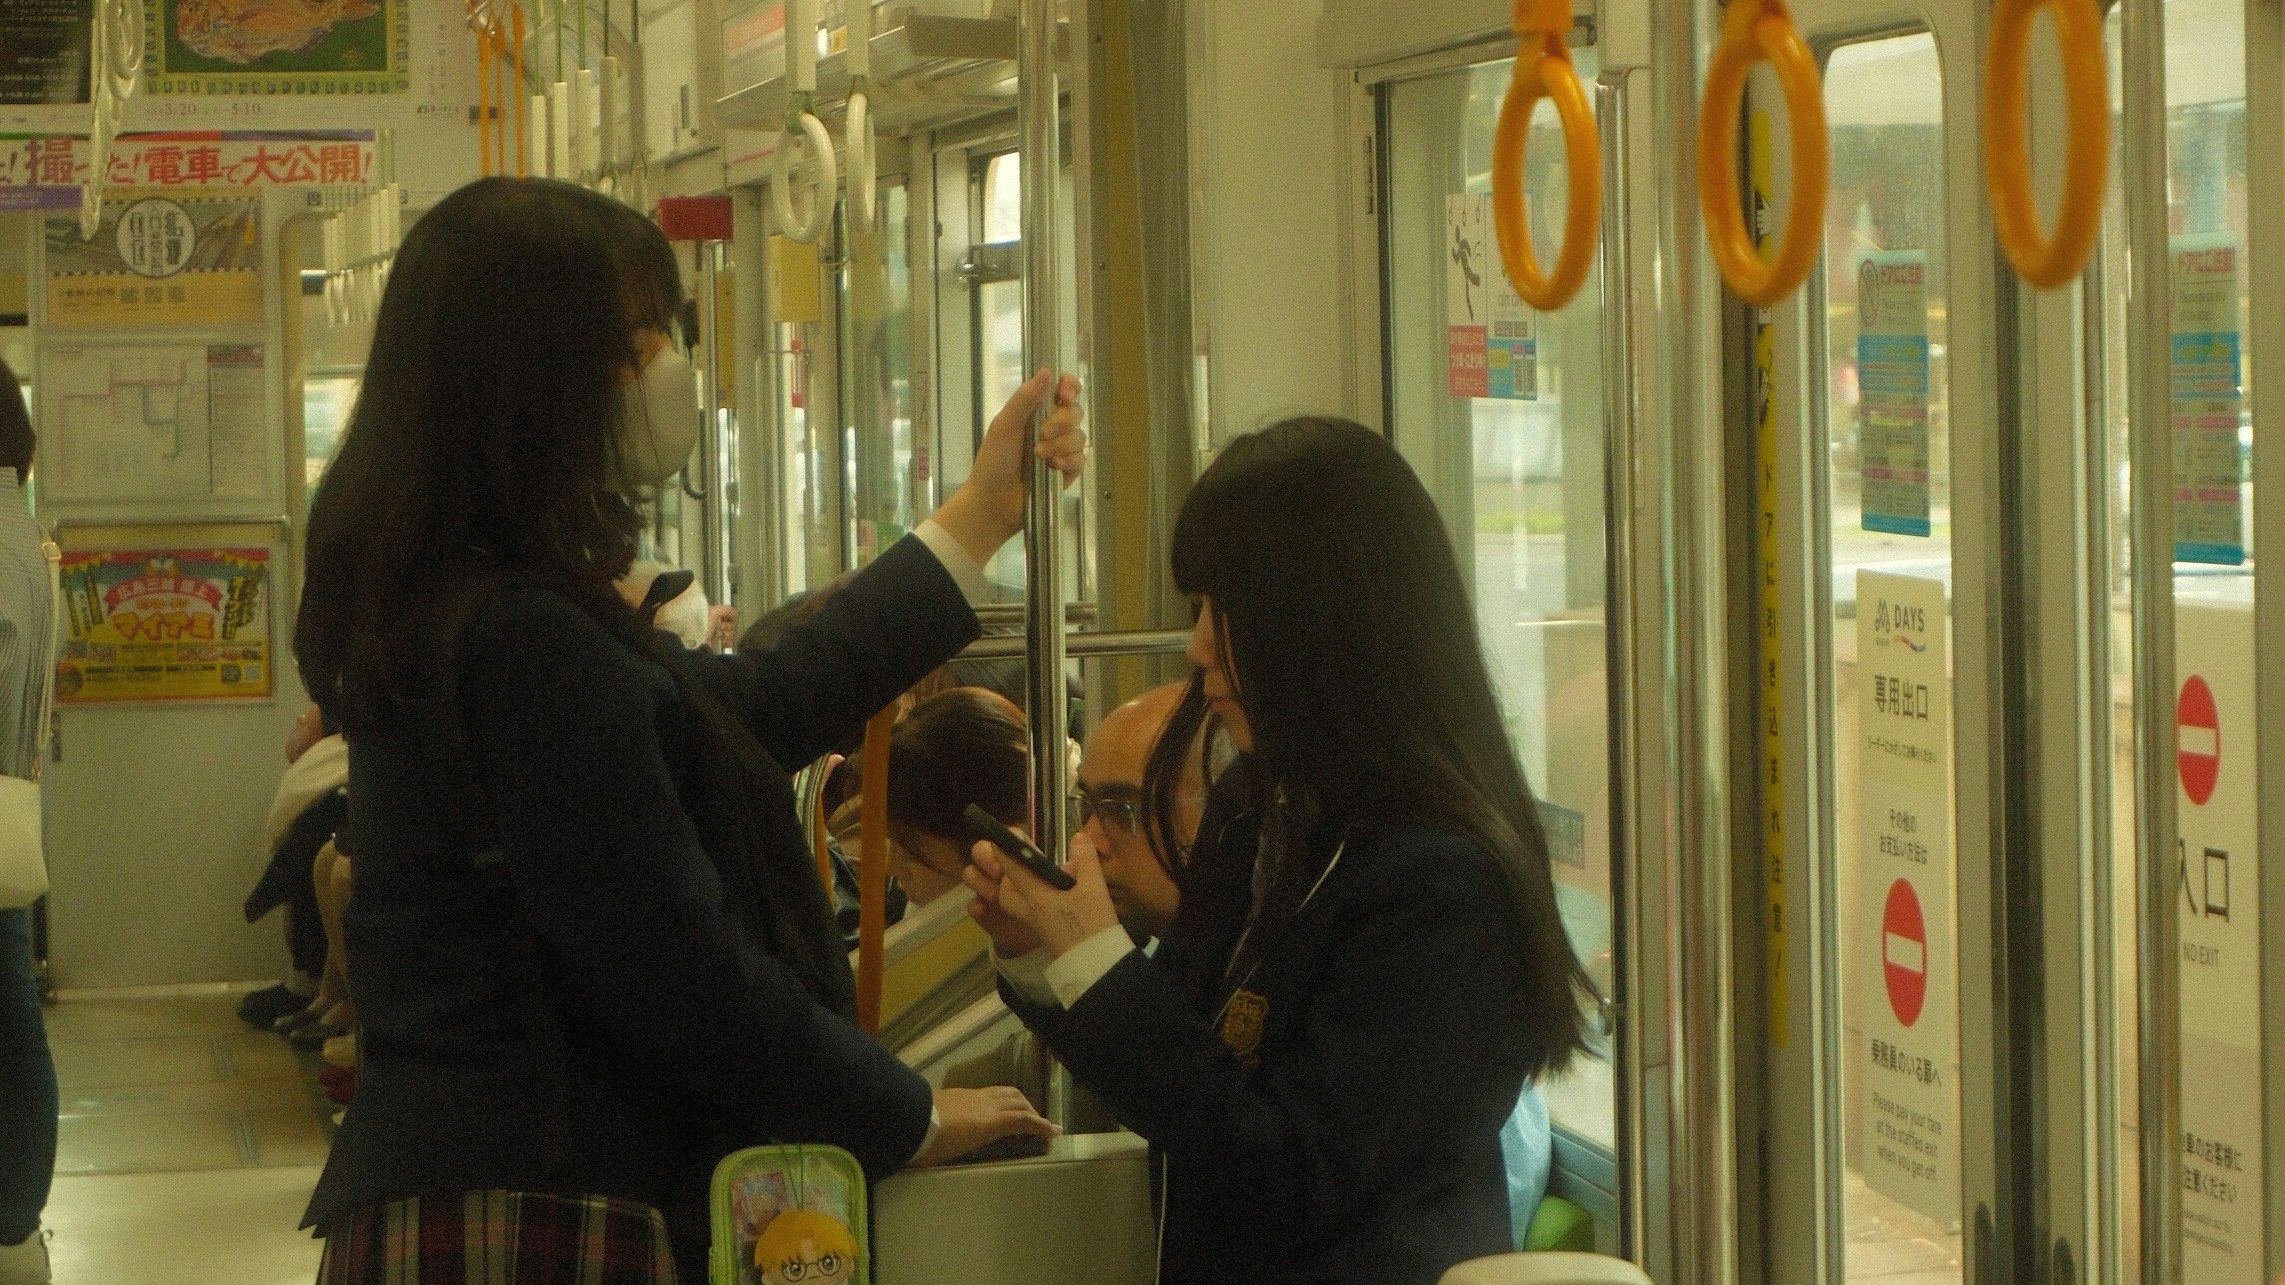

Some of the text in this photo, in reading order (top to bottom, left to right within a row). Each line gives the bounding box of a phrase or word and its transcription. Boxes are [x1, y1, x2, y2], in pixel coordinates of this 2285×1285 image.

[1893, 604, 1925, 633] DAYS
[1874, 674, 1929, 721] 専用出口
[1889, 808, 1917, 833] その他の
[1879, 833, 1927, 865] お支払い方法は
[2183, 943, 2219, 967] NO EXIT
[2182, 1132, 2243, 1172] 車のお客様に
